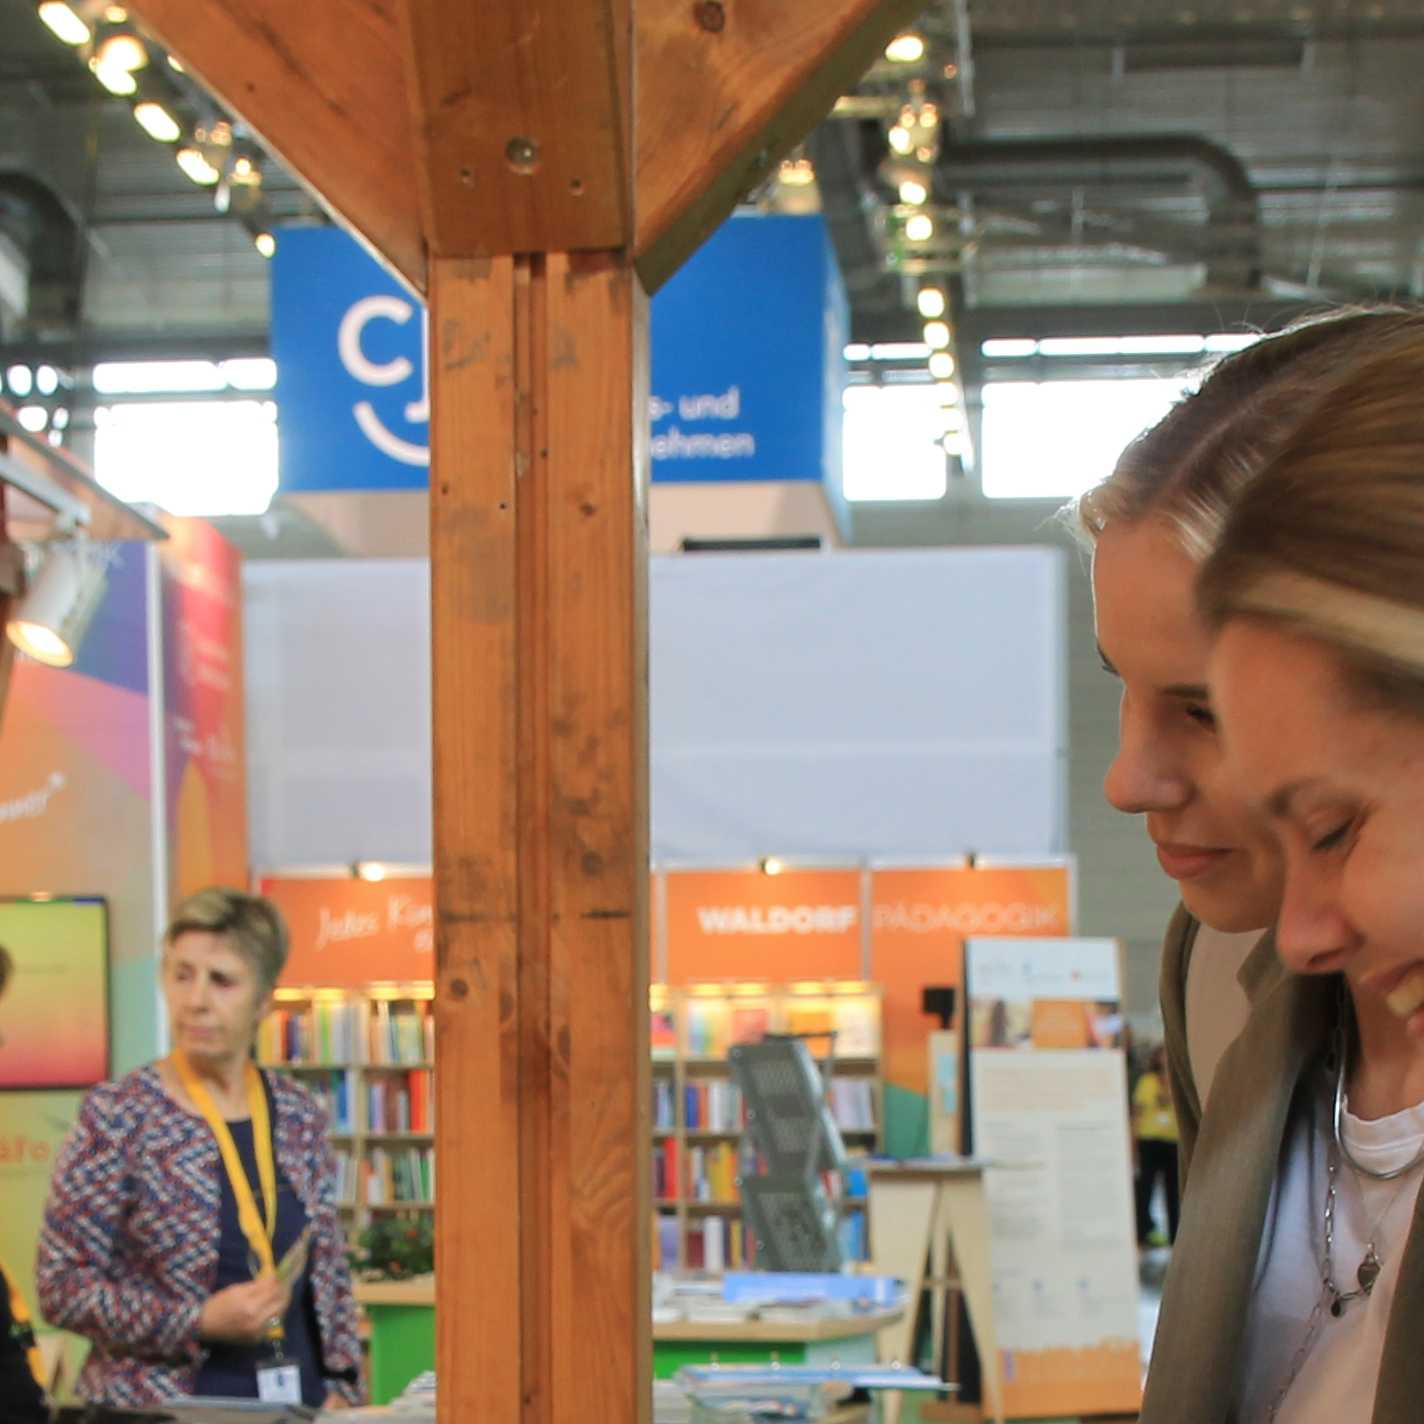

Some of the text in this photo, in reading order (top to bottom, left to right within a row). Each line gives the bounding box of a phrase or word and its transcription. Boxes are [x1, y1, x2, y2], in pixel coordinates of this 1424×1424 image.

[678, 385, 740, 421] und
[650, 424, 754, 460] ehmen
[696, 903, 857, 936] WALDORF
